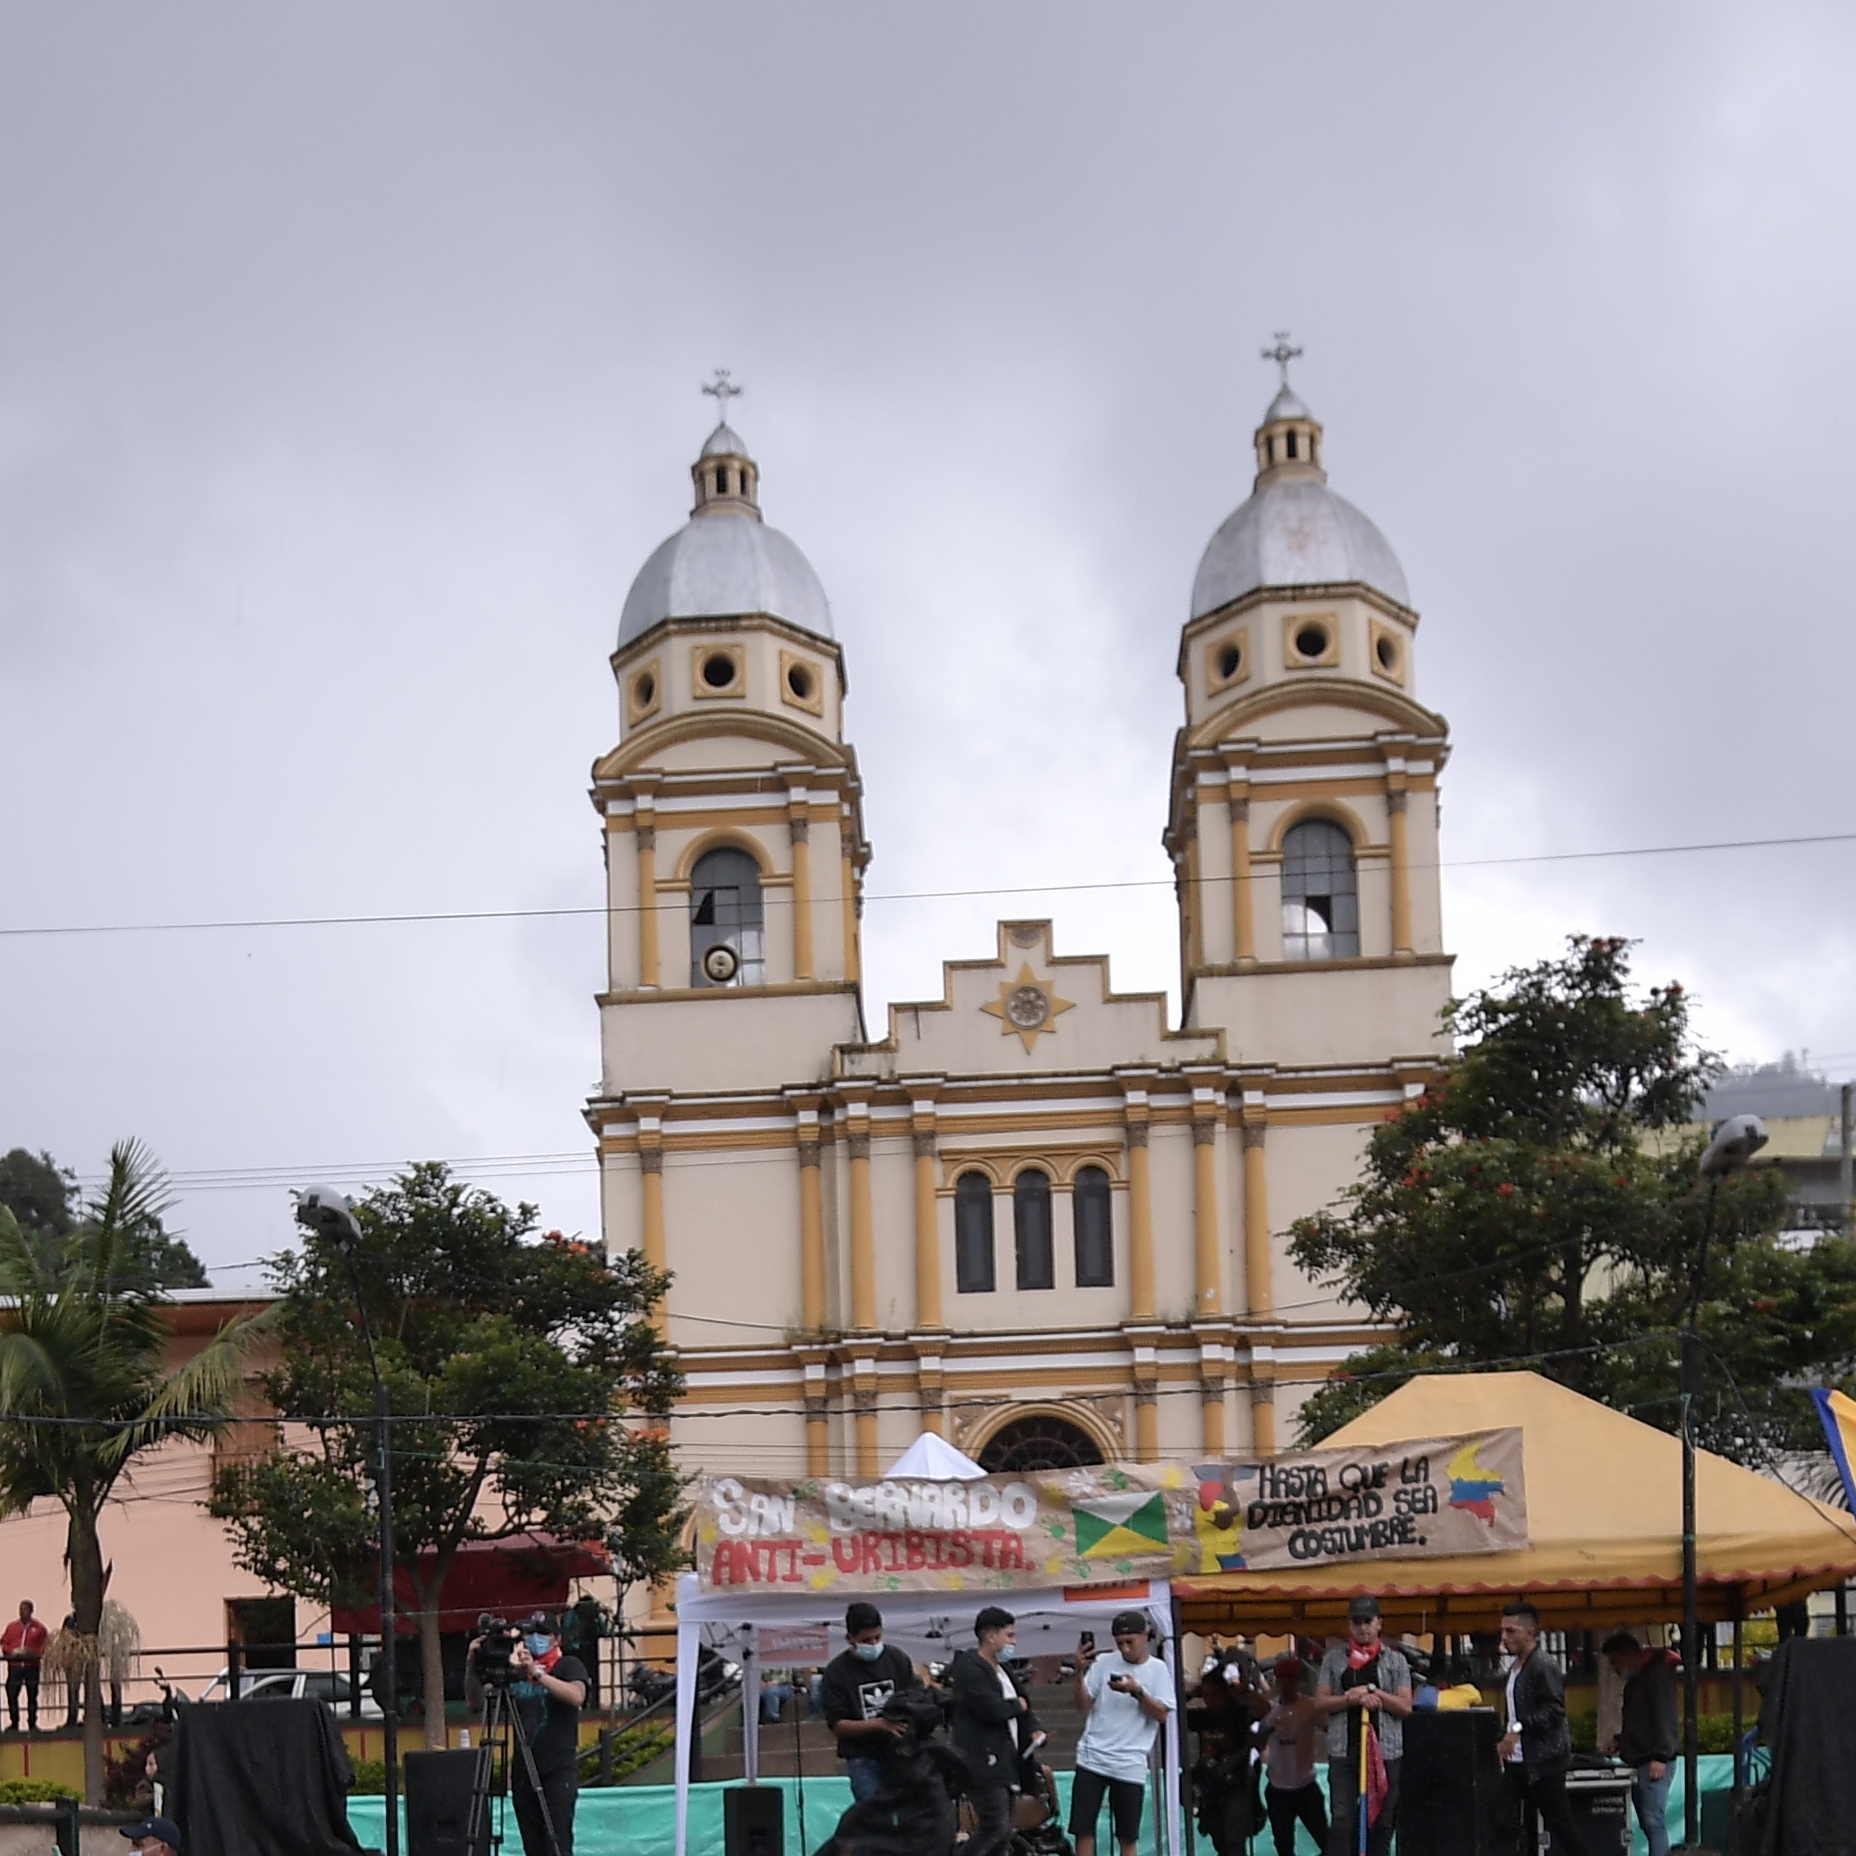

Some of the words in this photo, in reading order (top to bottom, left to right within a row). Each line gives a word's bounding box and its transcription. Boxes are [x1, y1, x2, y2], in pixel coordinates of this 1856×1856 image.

[1259, 1463, 1329, 1499] HASTA
[1339, 1462, 1390, 1493] QUE
[1401, 1456, 1430, 1485] LA
[713, 1478, 795, 1535] SAN
[825, 1480, 1037, 1532] BERNARDO
[1248, 1491, 1384, 1530] DIGNIDAD
[1393, 1484, 1438, 1516] SEA
[711, 1529, 1036, 1586] ANTI-URIBISTA.
[1288, 1515, 1428, 1560] COSTUMBRE.
